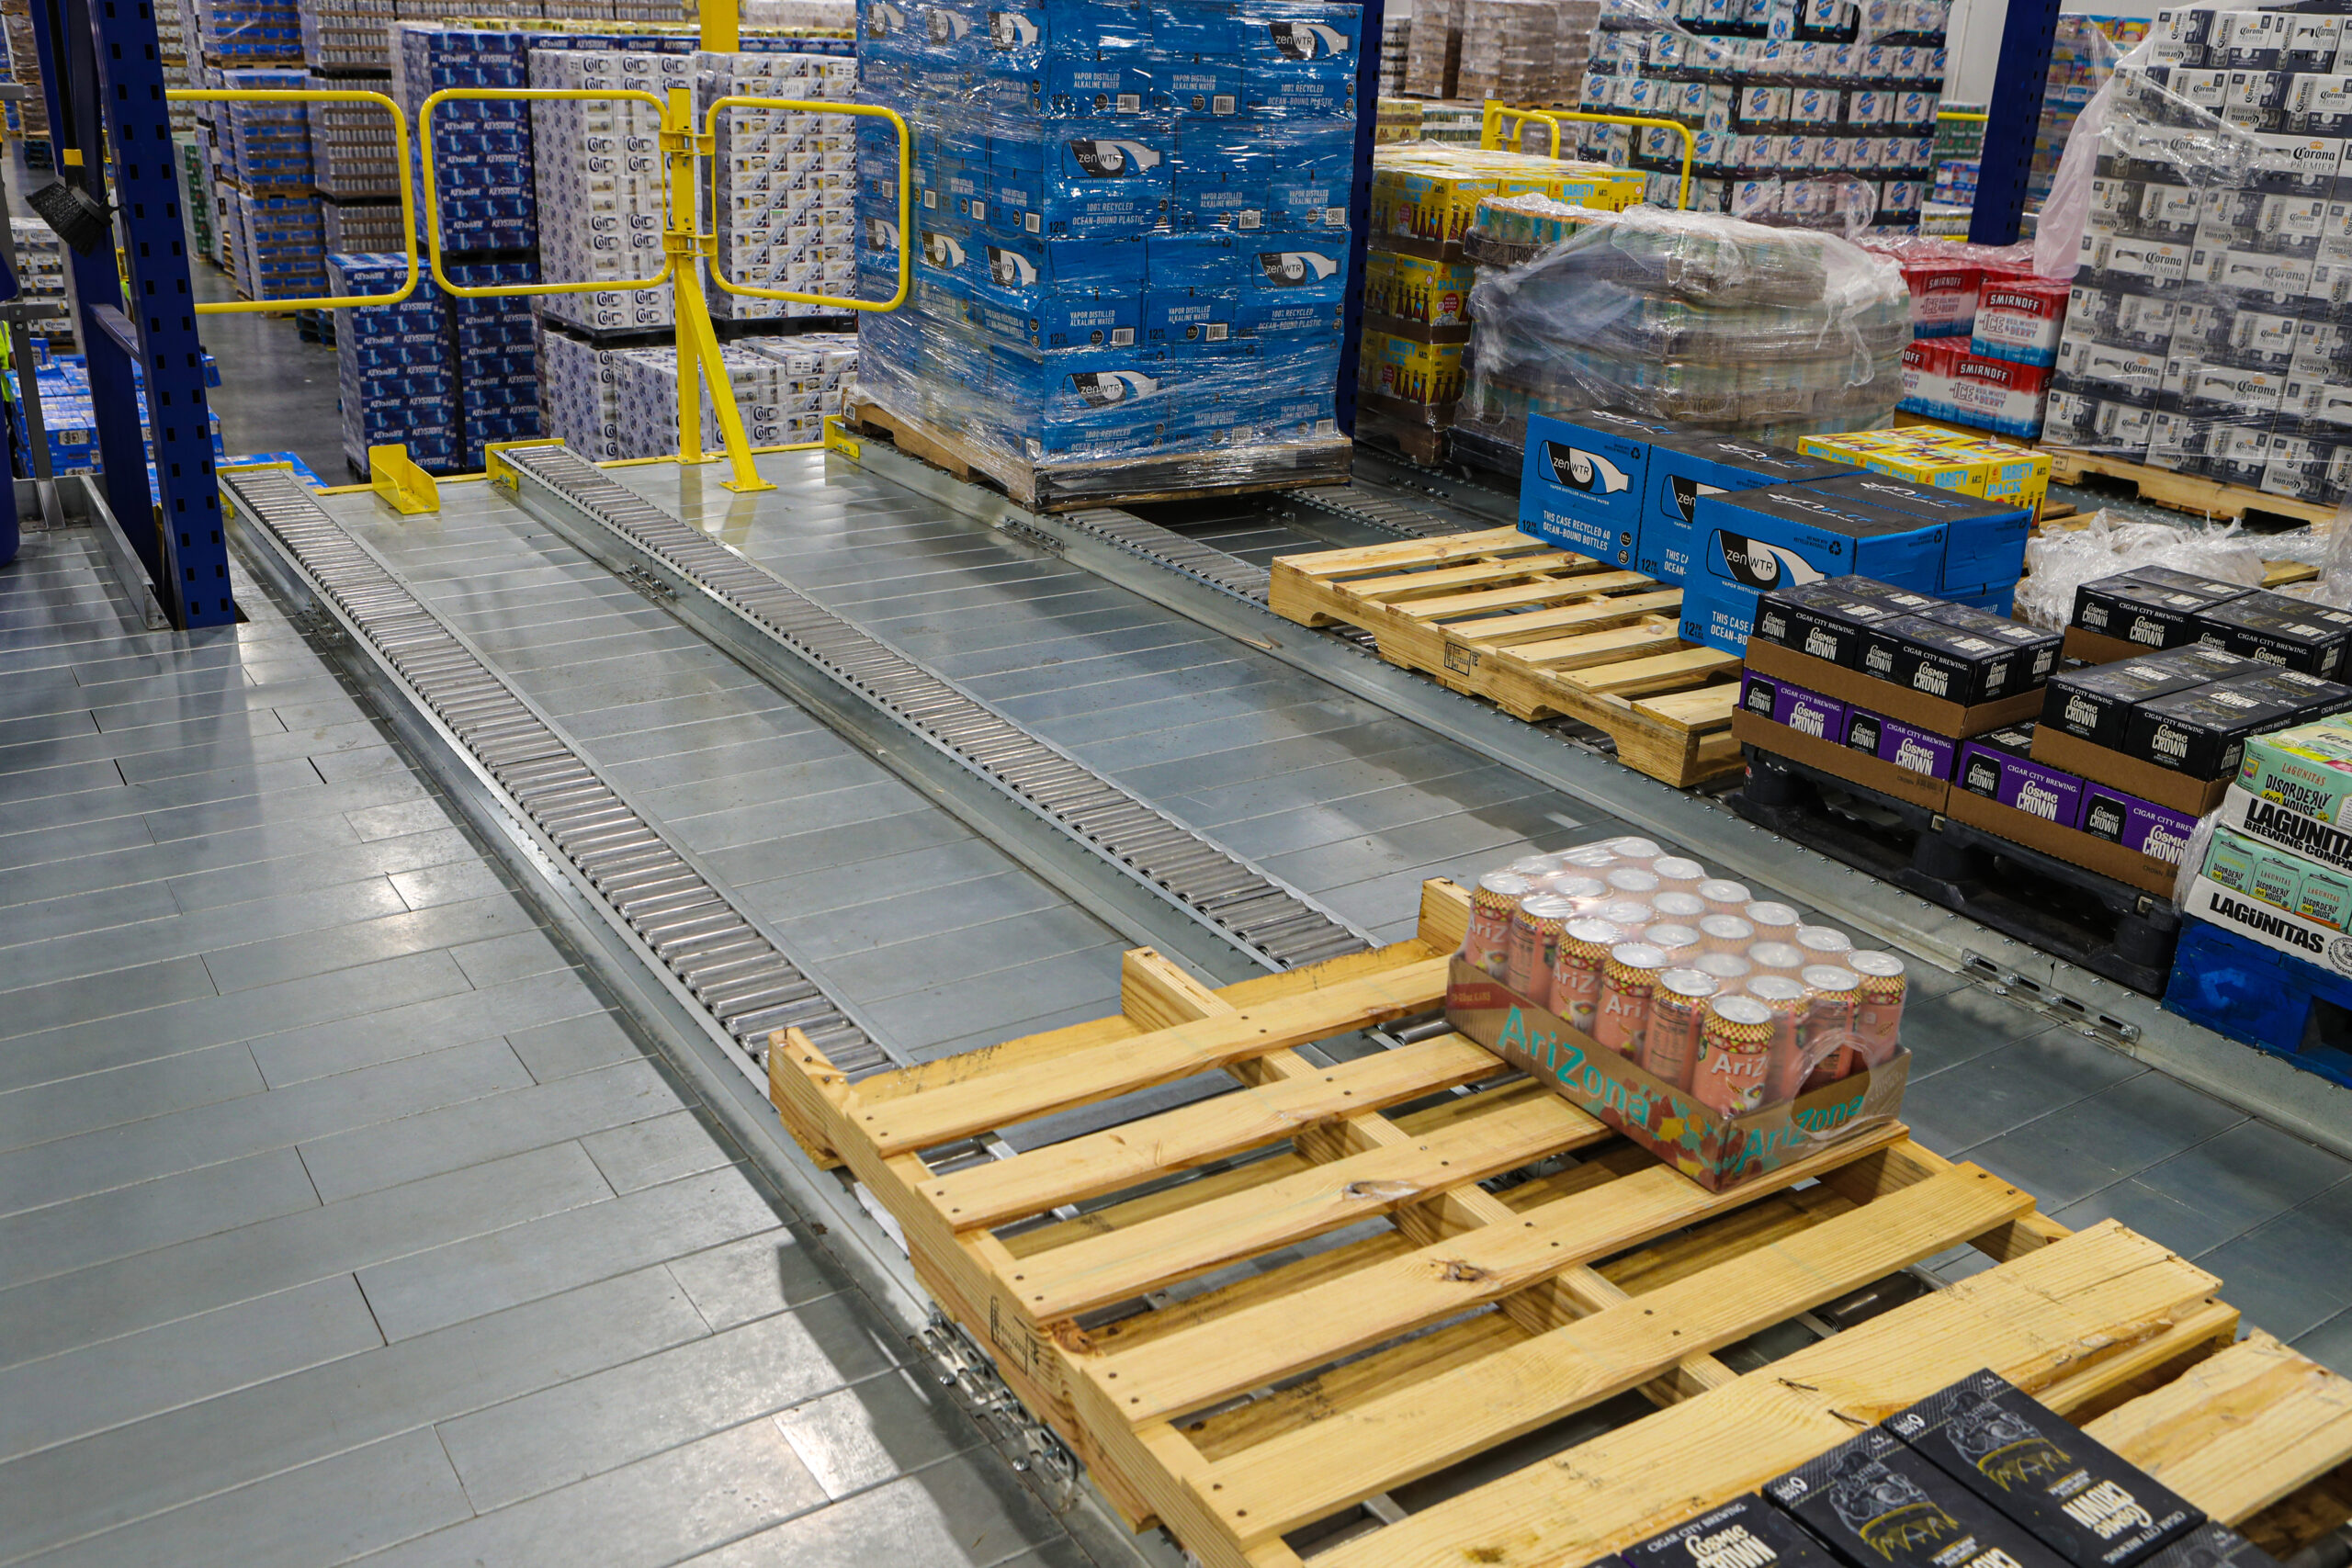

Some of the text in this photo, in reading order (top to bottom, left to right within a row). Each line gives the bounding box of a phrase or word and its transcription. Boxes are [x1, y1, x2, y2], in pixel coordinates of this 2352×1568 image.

[2240, 27, 2264, 36] Corona
[1073, 72, 1120, 82] VAPOR DISTILLED
[1073, 81, 1120, 89] ALKALINE WATER
[1295, 84, 1324, 94] RECYCLED
[2320, 90, 2346, 99] Corona
[2292, 146, 2335, 163] Corona
[2290, 160, 2334, 172] PREMIER
[1101, 201, 1134, 212] RECYCLED
[1072, 214, 1145, 225] OCEAN-BOUND PLASTIC
[2145, 252, 2182, 267] Corona
[2265, 265, 2305, 281] Corona
[1928, 276, 1962, 288] SMIRNOFF
[1990, 294, 2039, 311] SMIRNOFF
[1069, 310, 1115, 319] VAPOR DISTILLED
[1069, 317, 1114, 327] ALKALINE WATER
[1983, 313, 2005, 333] ICE
[2010, 327, 2037, 338] BERRY
[2018, 320, 2039, 330] WHITE
[1960, 364, 2007, 381] SMIRNOFF
[1953, 382, 1974, 402] ICE
[1987, 389, 2007, 400] WHITE
[2237, 381, 2277, 396] Corona
[1979, 398, 2006, 409] BERRY
[1553, 456, 1589, 477] zenWTR
[2001, 463, 2034, 480] VARIETY
[1986, 481, 2021, 497] PACK
[1544, 510, 1555, 522] THIS
[1556, 514, 1571, 527] CASE
[1572, 519, 1602, 536] RECYCLED
[1602, 530, 1611, 540] 60
[1543, 521, 1608, 551] OCEAN-BOUND BOTTLES
[1666, 548, 1681, 562] THIS
[1726, 549, 1773, 573] zenWTR
[1722, 581, 1736, 589] VAPOR
[2086, 603, 2109, 615] COSMIC
[2119, 602, 2138, 613] CIGAR
[2139, 606, 2154, 616] CITY
[1713, 610, 1748, 632] THIS CASE
[1765, 612, 1786, 626] COSMIC
[1795, 612, 1814, 626] CIGAR
[1815, 617, 1827, 628] CITY
[2082, 611, 2108, 628] CROWN
[2135, 615, 2165, 633] COSMIC
[1684, 621, 1694, 637] 12
[1762, 621, 1785, 638] CROWN
[1811, 626, 1838, 645] COSMIC
[2130, 626, 2164, 648] CROWN
[2238, 632, 2258, 644] CIGAR
[2259, 637, 2274, 649] CITY
[1805, 639, 1838, 660] CROWN
[1869, 644, 1893, 660] COSMIC
[1903, 646, 1924, 660] CIGAR
[1924, 650, 1939, 663] CITY
[2255, 646, 2287, 665] COSMIC
[1866, 655, 1892, 673] CROWN
[1918, 660, 1949, 682] COSMIC
[1913, 673, 1948, 697] CROWN
[2058, 683, 2087, 699] CIGAR CITY
[1748, 694, 1770, 712] CROWN
[1752, 687, 1771, 702] COSMIC
[1781, 687, 1797, 698] CIGAR
[1799, 693, 1812, 702] CITY
[1794, 701, 1825, 722] COSMIC
[2070, 694, 2098, 714] COSMIC
[2064, 705, 2098, 728] CROWN
[2144, 712, 2177, 727] CIGAR CITY
[1790, 713, 1824, 738] CROWN
[1855, 723, 1876, 738] COSMIC
[1887, 723, 1905, 734] CIGAR
[1906, 728, 1921, 738] CITY
[1851, 730, 1875, 749] CROWN
[2157, 725, 2188, 744] COSMIC
[1901, 738, 1934, 760] COSMIC
[2152, 735, 2188, 759] CROWN
[1895, 750, 1933, 775] CROWN
[1973, 763, 1995, 779] COSMIC
[2007, 764, 2027, 776] CIGAR
[2029, 770, 2044, 781] CITY
[2281, 762, 2326, 786] LAGUNITAS
[1968, 772, 1994, 791] CROWN
[2022, 781, 2058, 803] COSMIC
[2017, 792, 2057, 820] CROWN
[2094, 806, 2120, 822] COSMIC
[2089, 814, 2119, 835] CROWN
[2133, 807, 2174, 826] CIGAR CITY
[2244, 818, 2303, 851] BREWING
[2221, 875, 2238, 886] HOUSE
[2260, 870, 2291, 886] LAGUNITAS
[2266, 890, 2282, 903] HOUSE
[2307, 886, 2340, 903] LAGUNITAS
[2312, 907, 2331, 919] HOUSE
[2210, 892, 2324, 953] LAGUNITAS
[1497, 1005, 1650, 1129] AriZona
[1735, 1095, 1864, 1173] AriZona
[2062, 1480, 2135, 1528] CROWN
[2094, 1502, 2153, 1540] COSMIC
[1647, 1521, 1703, 1552] CIGAR CITY
[1685, 1524, 1749, 1559] COSMIC
